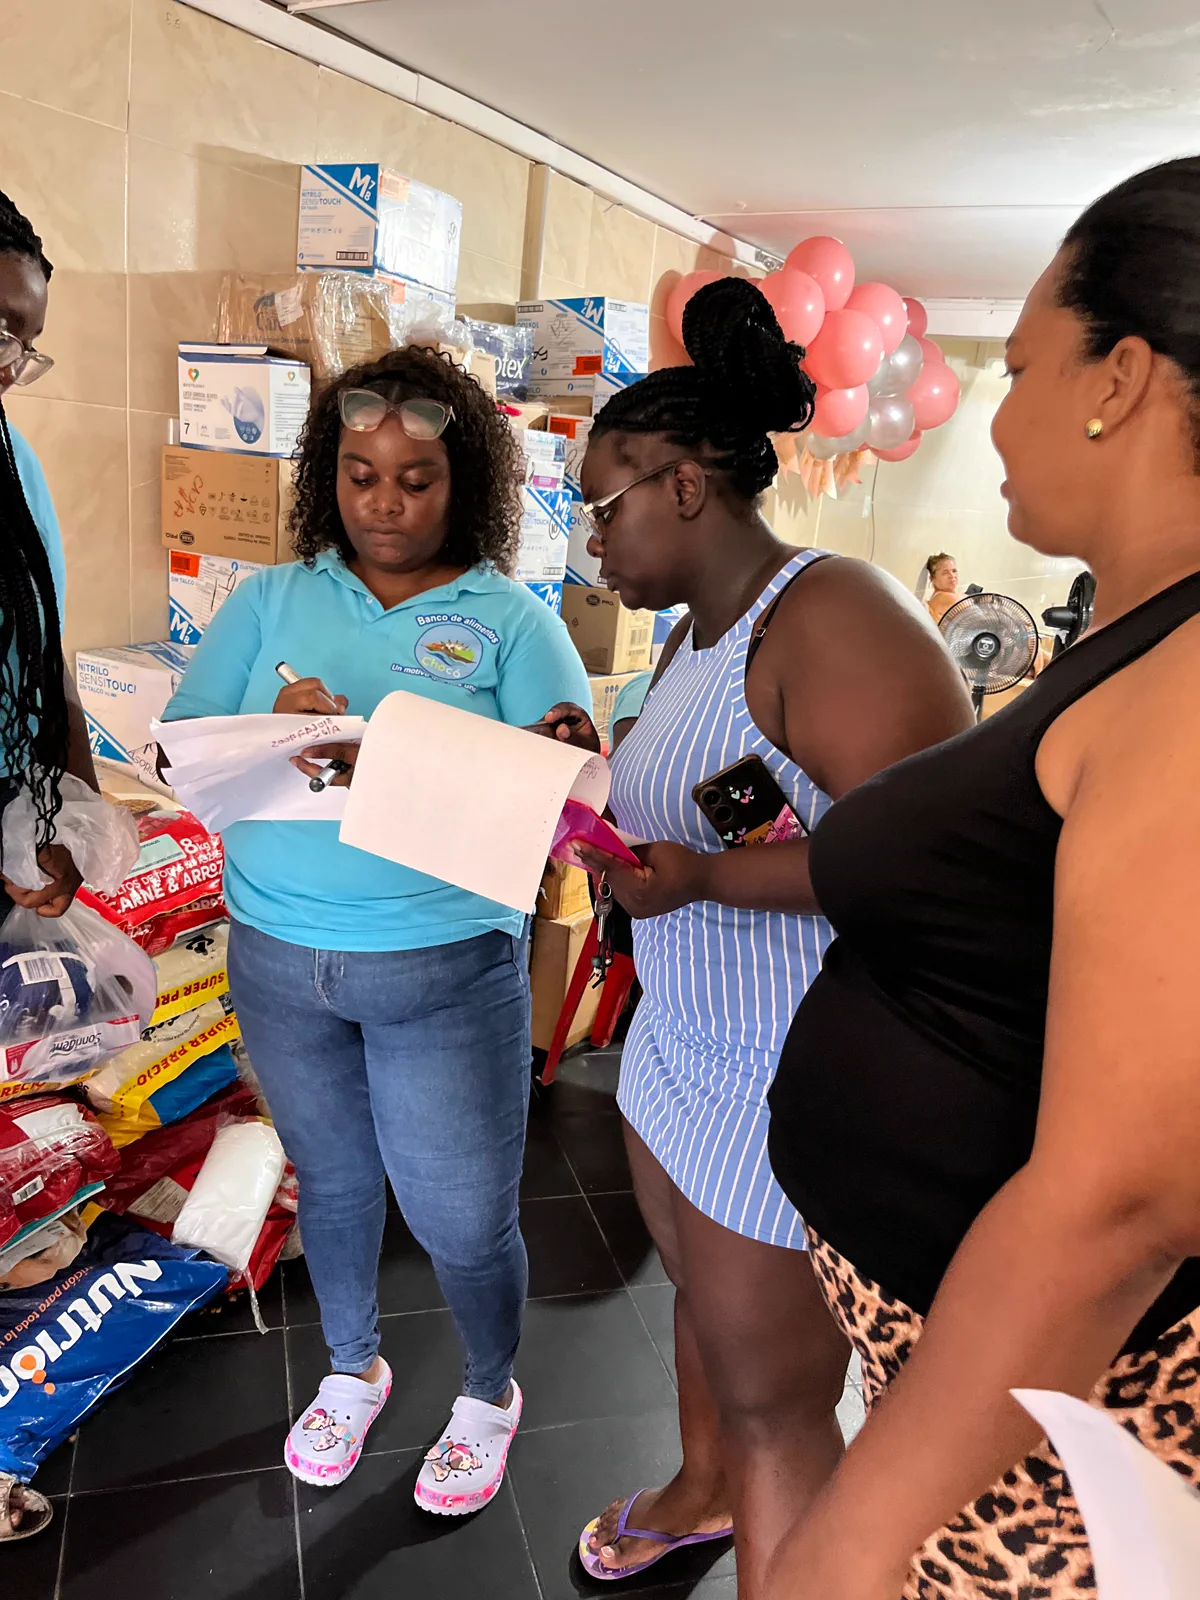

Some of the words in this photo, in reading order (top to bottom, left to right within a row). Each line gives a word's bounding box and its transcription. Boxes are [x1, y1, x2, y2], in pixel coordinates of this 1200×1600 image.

[348, 166, 372, 199] M
[368, 180, 376, 190] 7
[364, 191, 372, 201] 8
[585, 300, 604, 324] M
[494, 355, 529, 380] otex
[184, 422, 190, 435] 7
[170, 611, 189, 641] M
[187, 626, 194, 635] 7
[416, 615, 448, 626] Banco
[450, 614, 462, 622] de
[464, 618, 499, 644] alimentos
[184, 635, 190, 644] 8
[78, 663, 109, 676] NITRILO
[391, 664, 402, 672] Un
[403, 666, 430, 677] motivo
[97, 736, 104, 746] 7
[94, 746, 101, 755] 8
[180, 838, 198, 854] 8
[198, 841, 210, 851] kg
[100, 880, 141, 902] DLTOS
[168, 876, 180, 893] &
[183, 972, 225, 997] SÚPER
[188, 1016, 234, 1048] SÚPER
[50, 1032, 102, 1052] Sonrident
[136, 1045, 188, 1088] PRECIO
[38, 1286, 62, 1313] para
[15, 1310, 40, 1332] toda
[4, 1330, 18, 1342] la
